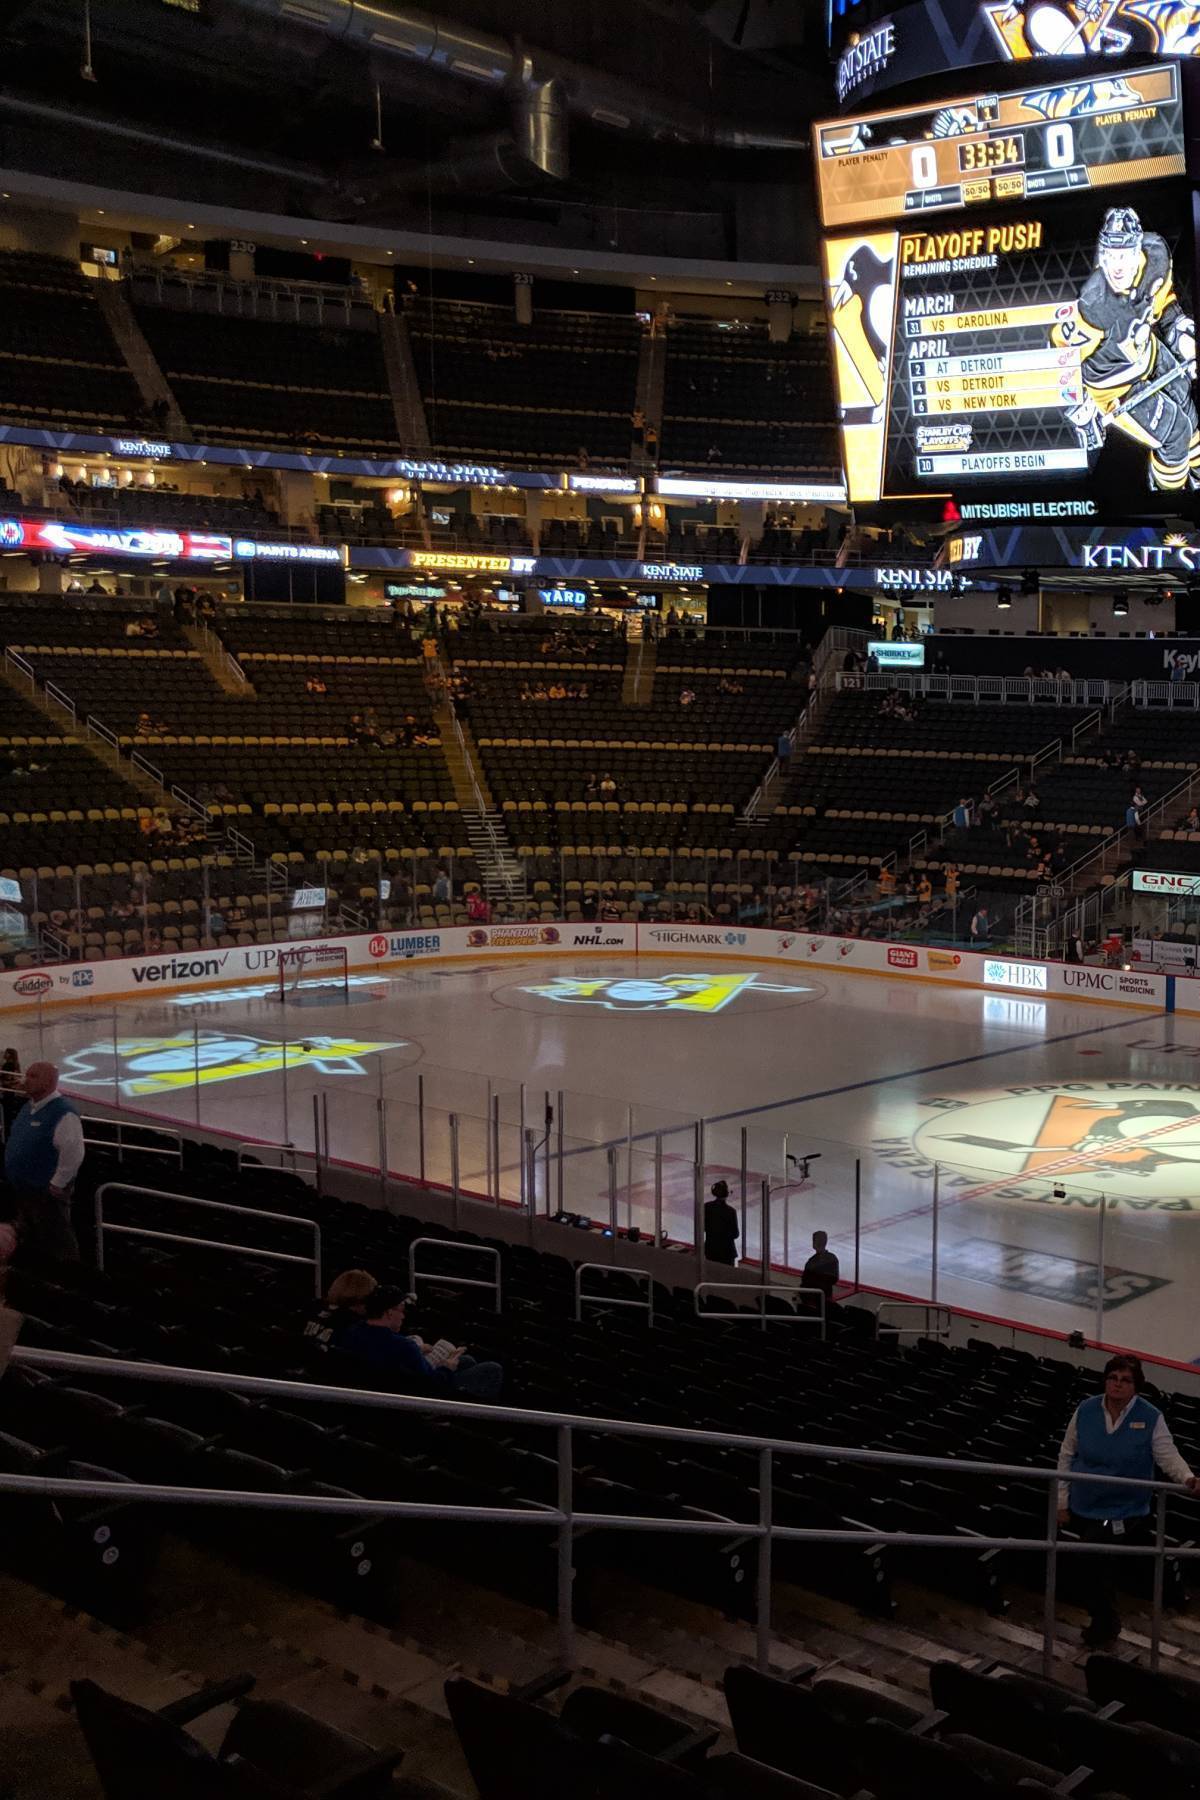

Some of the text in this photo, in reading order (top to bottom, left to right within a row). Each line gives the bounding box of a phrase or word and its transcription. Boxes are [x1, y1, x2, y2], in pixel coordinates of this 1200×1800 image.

[855, 25, 896, 71] STATE
[1096, 108, 1157, 126] PLAYER PENALTY
[965, 138, 1018, 169] 33:34
[1047, 123, 1074, 168] 0
[838, 151, 889, 167] PLAYER PENALTY
[912, 146, 937, 188] 0
[903, 222, 1042, 263] PLAYOFF PUSH
[904, 255, 998, 277] REMAINING SCHEDULE
[904, 295, 954, 316] MARCH
[910, 312, 1008, 333] 31 VS CAROLINA
[909, 339, 950, 359] APRIL
[915, 357, 1003, 375] 2 AT DETROIT
[937, 376, 1005, 392] VS DETROIT
[918, 394, 1017, 412] 6 VS NEW YORK
[918, 426, 952, 437] STANLEY
[120, 441, 146, 452] KENT
[148, 444, 171, 455] STATE
[921, 454, 1045, 472] 10 PLAYOFFS BEGIN
[407, 470, 497, 485] UNIVERSITY
[960, 500, 1095, 519] MITSUBISHI ELECTRIC
[257, 545, 298, 557] PAINTS
[299, 547, 340, 560] ARENA
[963, 536, 983, 560] BY
[1082, 545, 1172, 569] KENT
[413, 553, 537, 571] PRESENTED BY
[643, 565, 703, 578] KENT STATE
[544, 591, 586, 604] YARD
[843, 678, 860, 688] 121
[1142, 874, 1193, 888] GNC
[491, 927, 538, 937] PHANTOM
[649, 929, 722, 945] HIGHMARK
[390, 935, 440, 951] LUMBER
[245, 949, 312, 970] UPMC
[889, 950, 914, 959] GIANT
[890, 957, 915, 966] EAGLE
[132, 958, 218, 983] verizon
[1008, 965, 1044, 987] HBK
[13, 975, 70, 992] Glidden by
[1063, 970, 1113, 991] UPMC
[1119, 976, 1149, 986] SPORTS
[1119, 984, 1155, 996] MEDICINE
[1005, 1082, 1095, 1096] PPG
